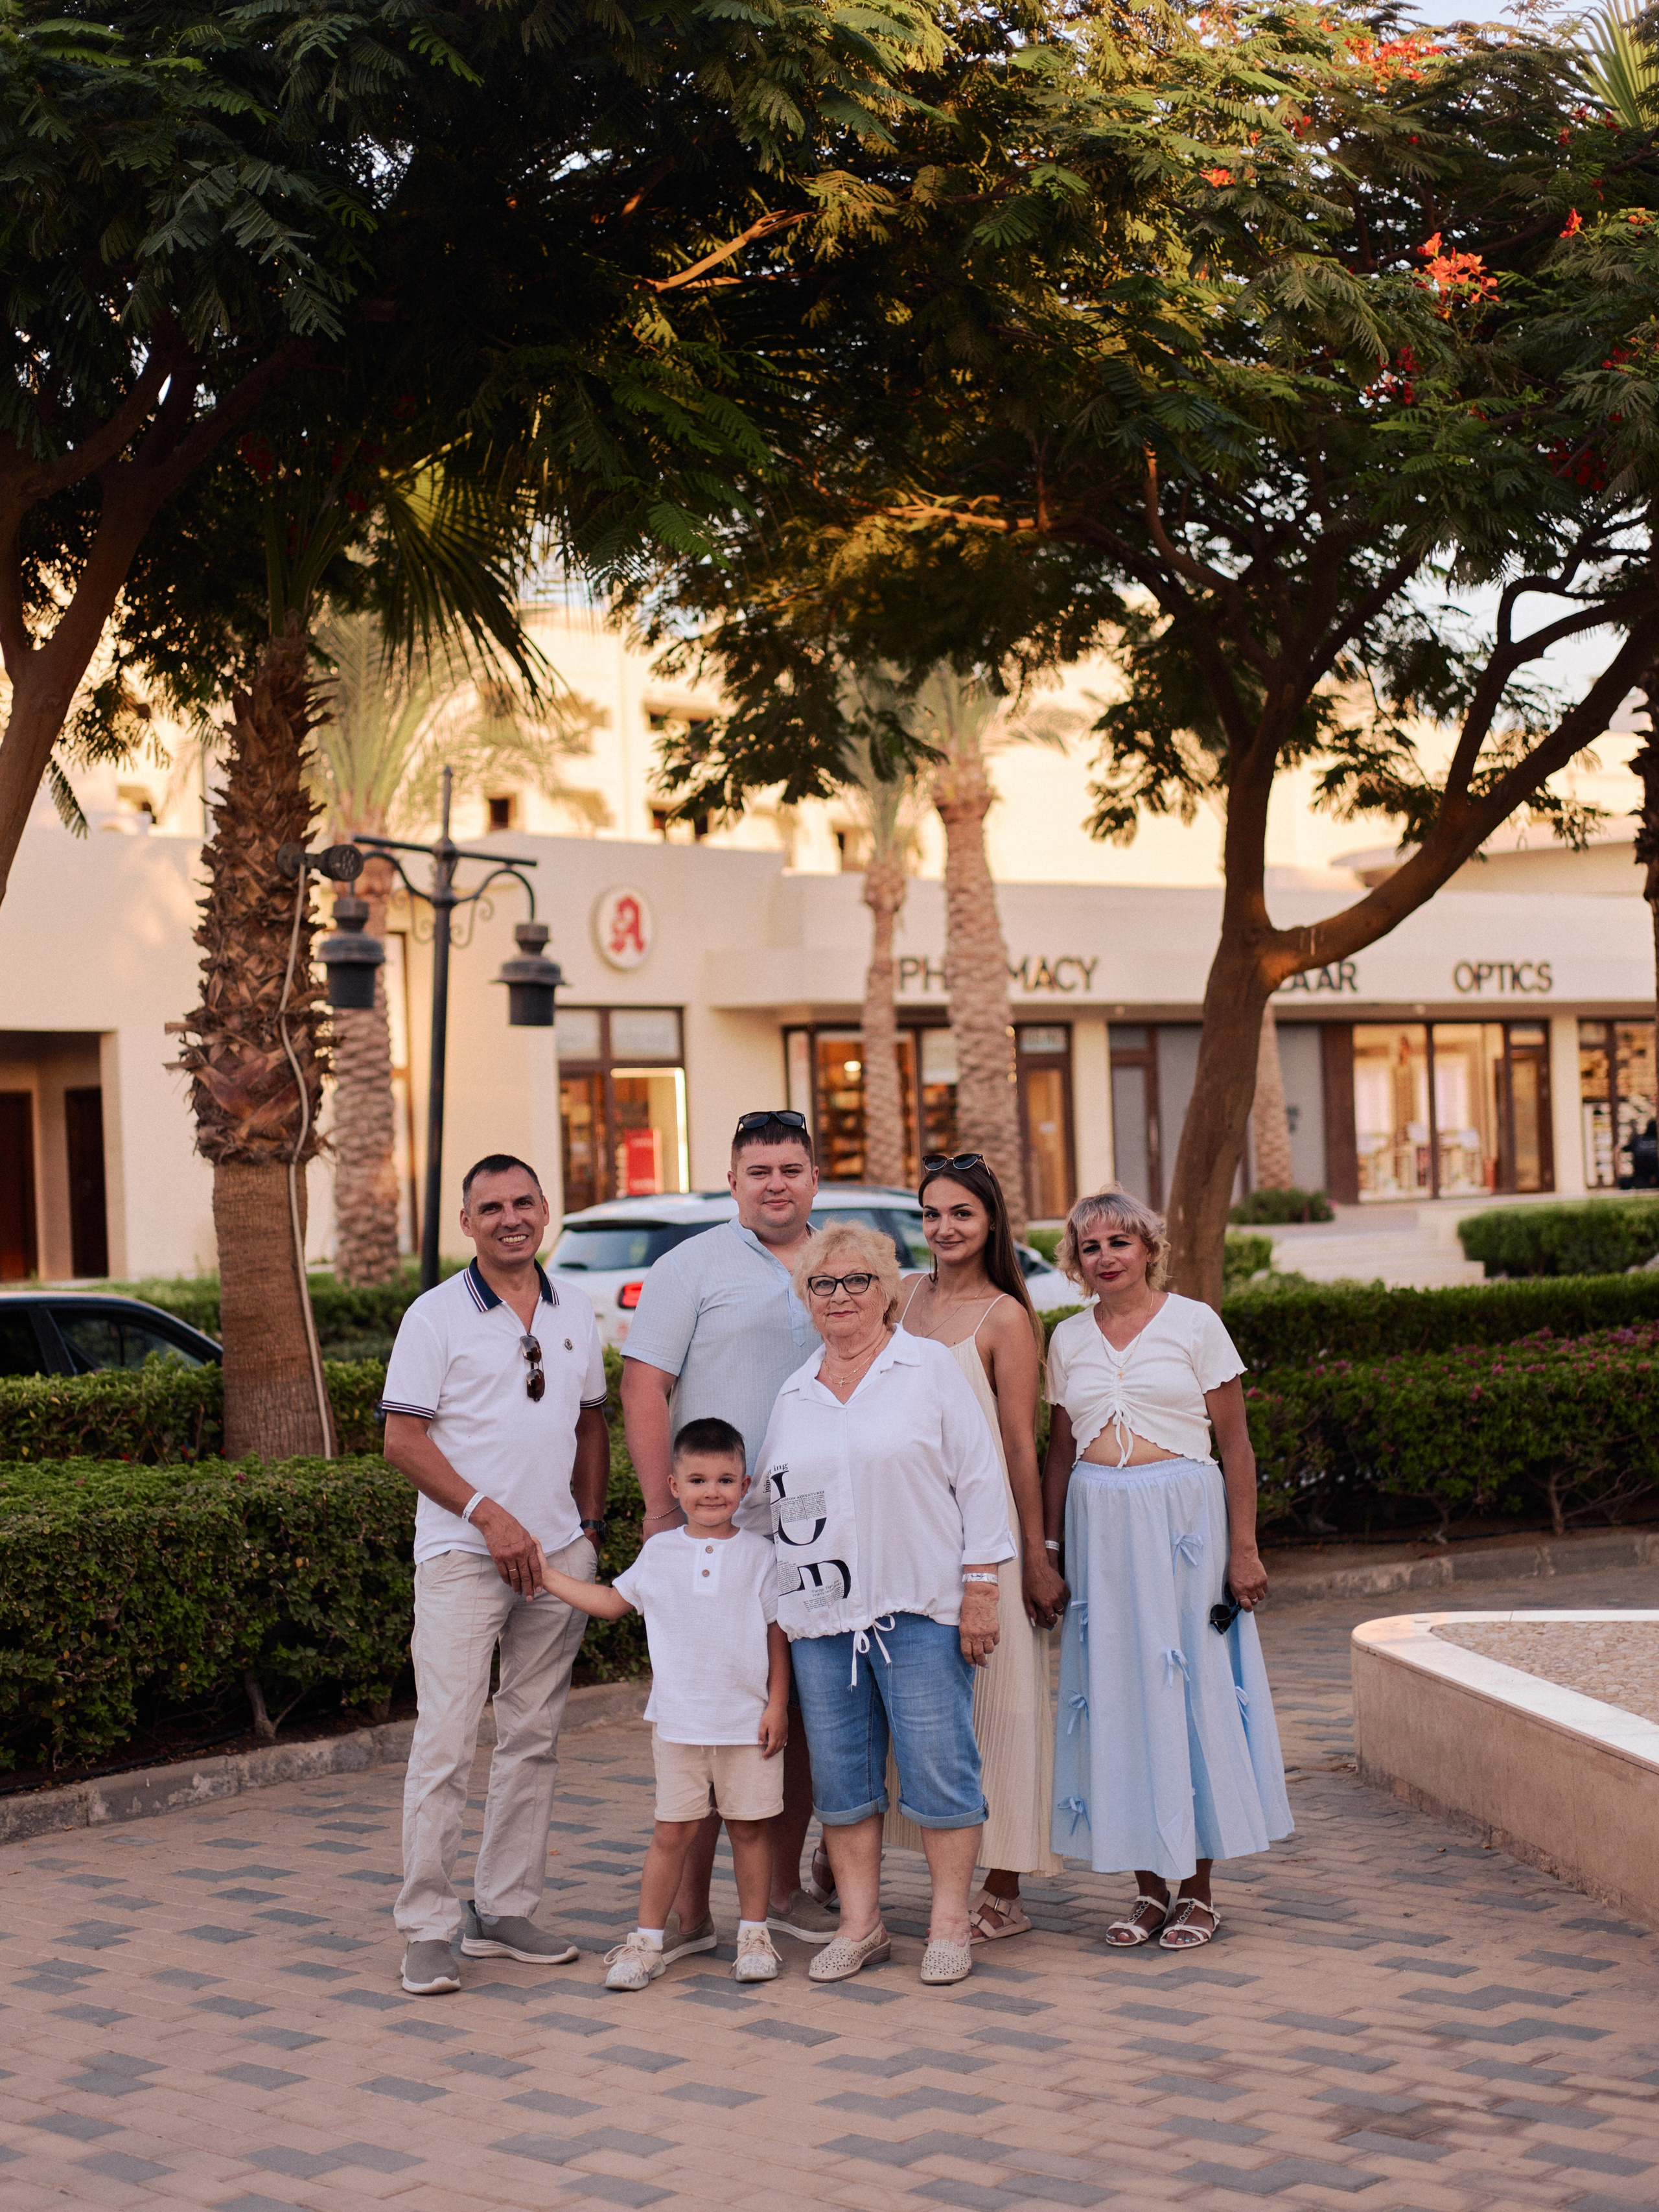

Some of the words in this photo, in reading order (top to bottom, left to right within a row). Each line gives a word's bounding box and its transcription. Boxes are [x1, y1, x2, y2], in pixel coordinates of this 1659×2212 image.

[900, 957, 1098, 991] PHMACY
[1454, 962, 1553, 993] OPTICS
[796, 1491, 825, 1500] ADVENTURES
